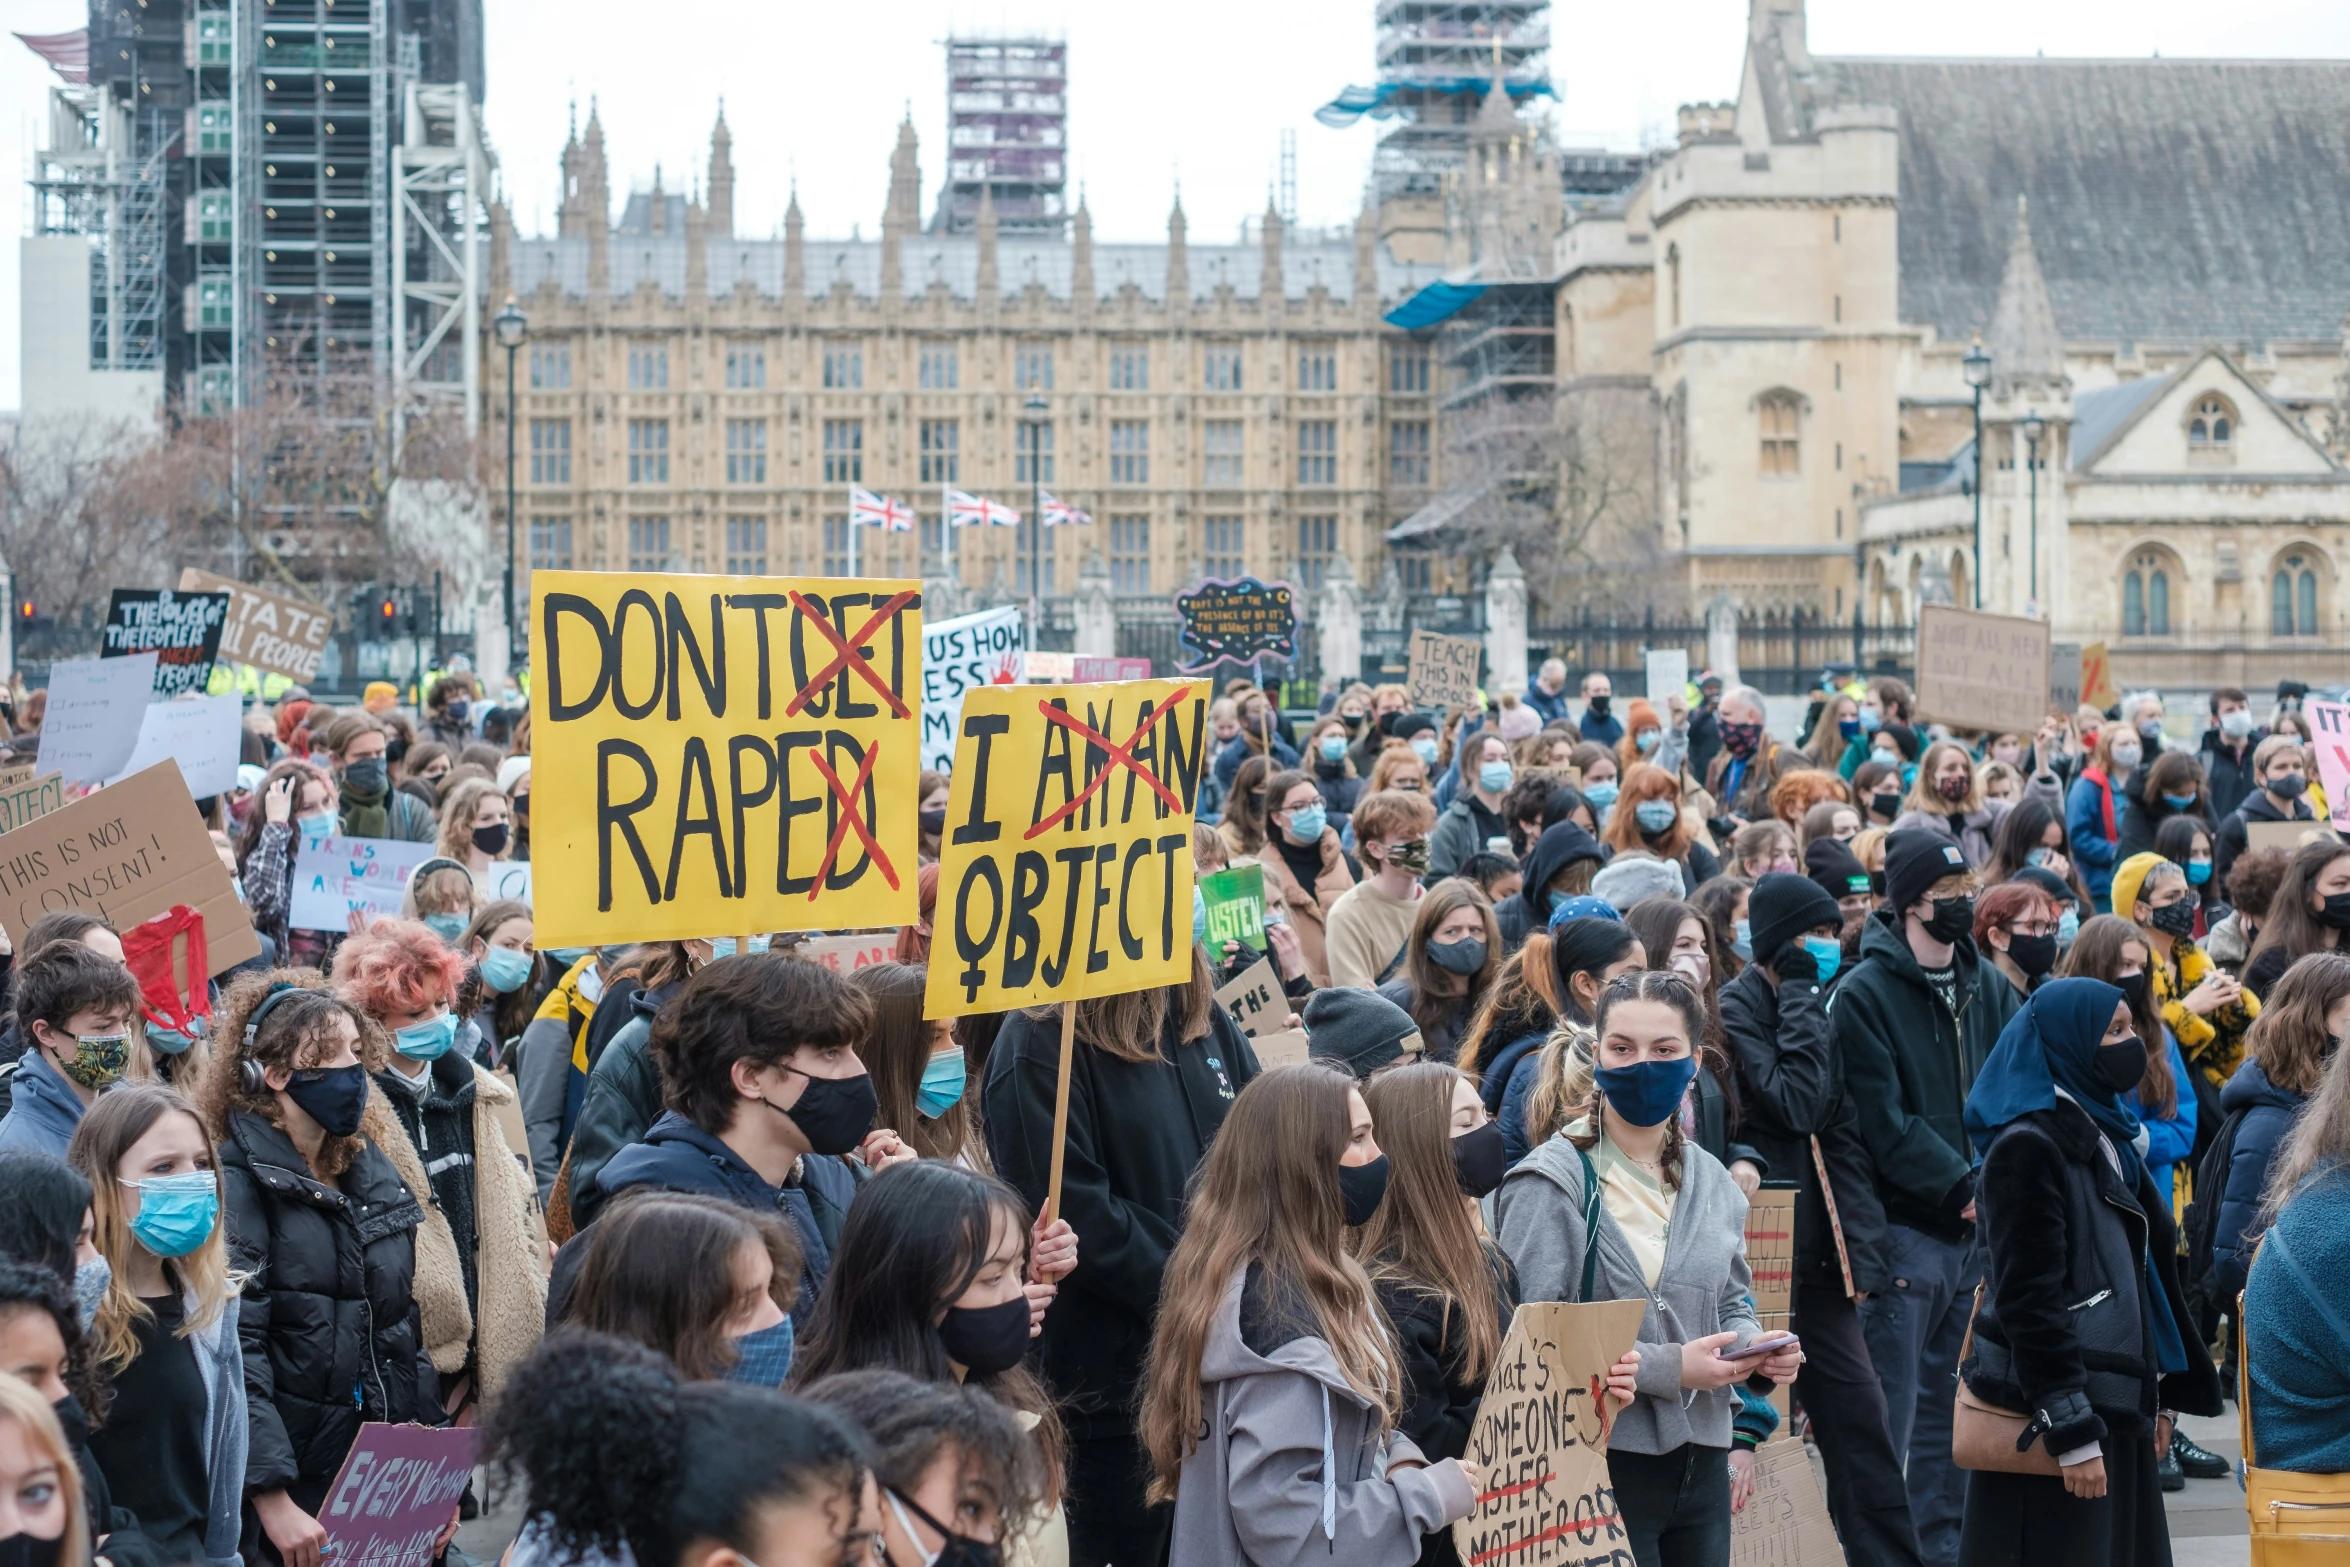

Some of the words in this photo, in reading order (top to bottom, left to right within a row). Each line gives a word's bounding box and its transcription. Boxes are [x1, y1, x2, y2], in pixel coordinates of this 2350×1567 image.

[106, 624, 139, 650] THE
[138, 624, 189, 649] PEOPLE
[248, 630, 322, 679] PEOPLE
[788, 592, 922, 721] GET
[929, 631, 964, 662] US
[972, 622, 1021, 657] HOW
[1420, 636, 1476, 670] TEACH
[157, 660, 211, 688] PEOPLE
[1416, 662, 1448, 683] THIS
[1455, 669, 1471, 686] IN
[952, 714, 1009, 845] I
[598, 730, 878, 913] RAPED
[0, 851, 50, 897] THIS
[57, 838, 80, 866] IS
[88, 818, 128, 852] NOT
[309, 837, 376, 859] TRANS
[311, 873, 358, 896] ARE
[1208, 896, 1263, 944] LISTEN
[1229, 984, 1271, 1023] THE
[329, 1451, 423, 1522] EVERY
[1469, 1498, 1569, 1567] MOTHER
[1574, 1483, 1625, 1546] OR
